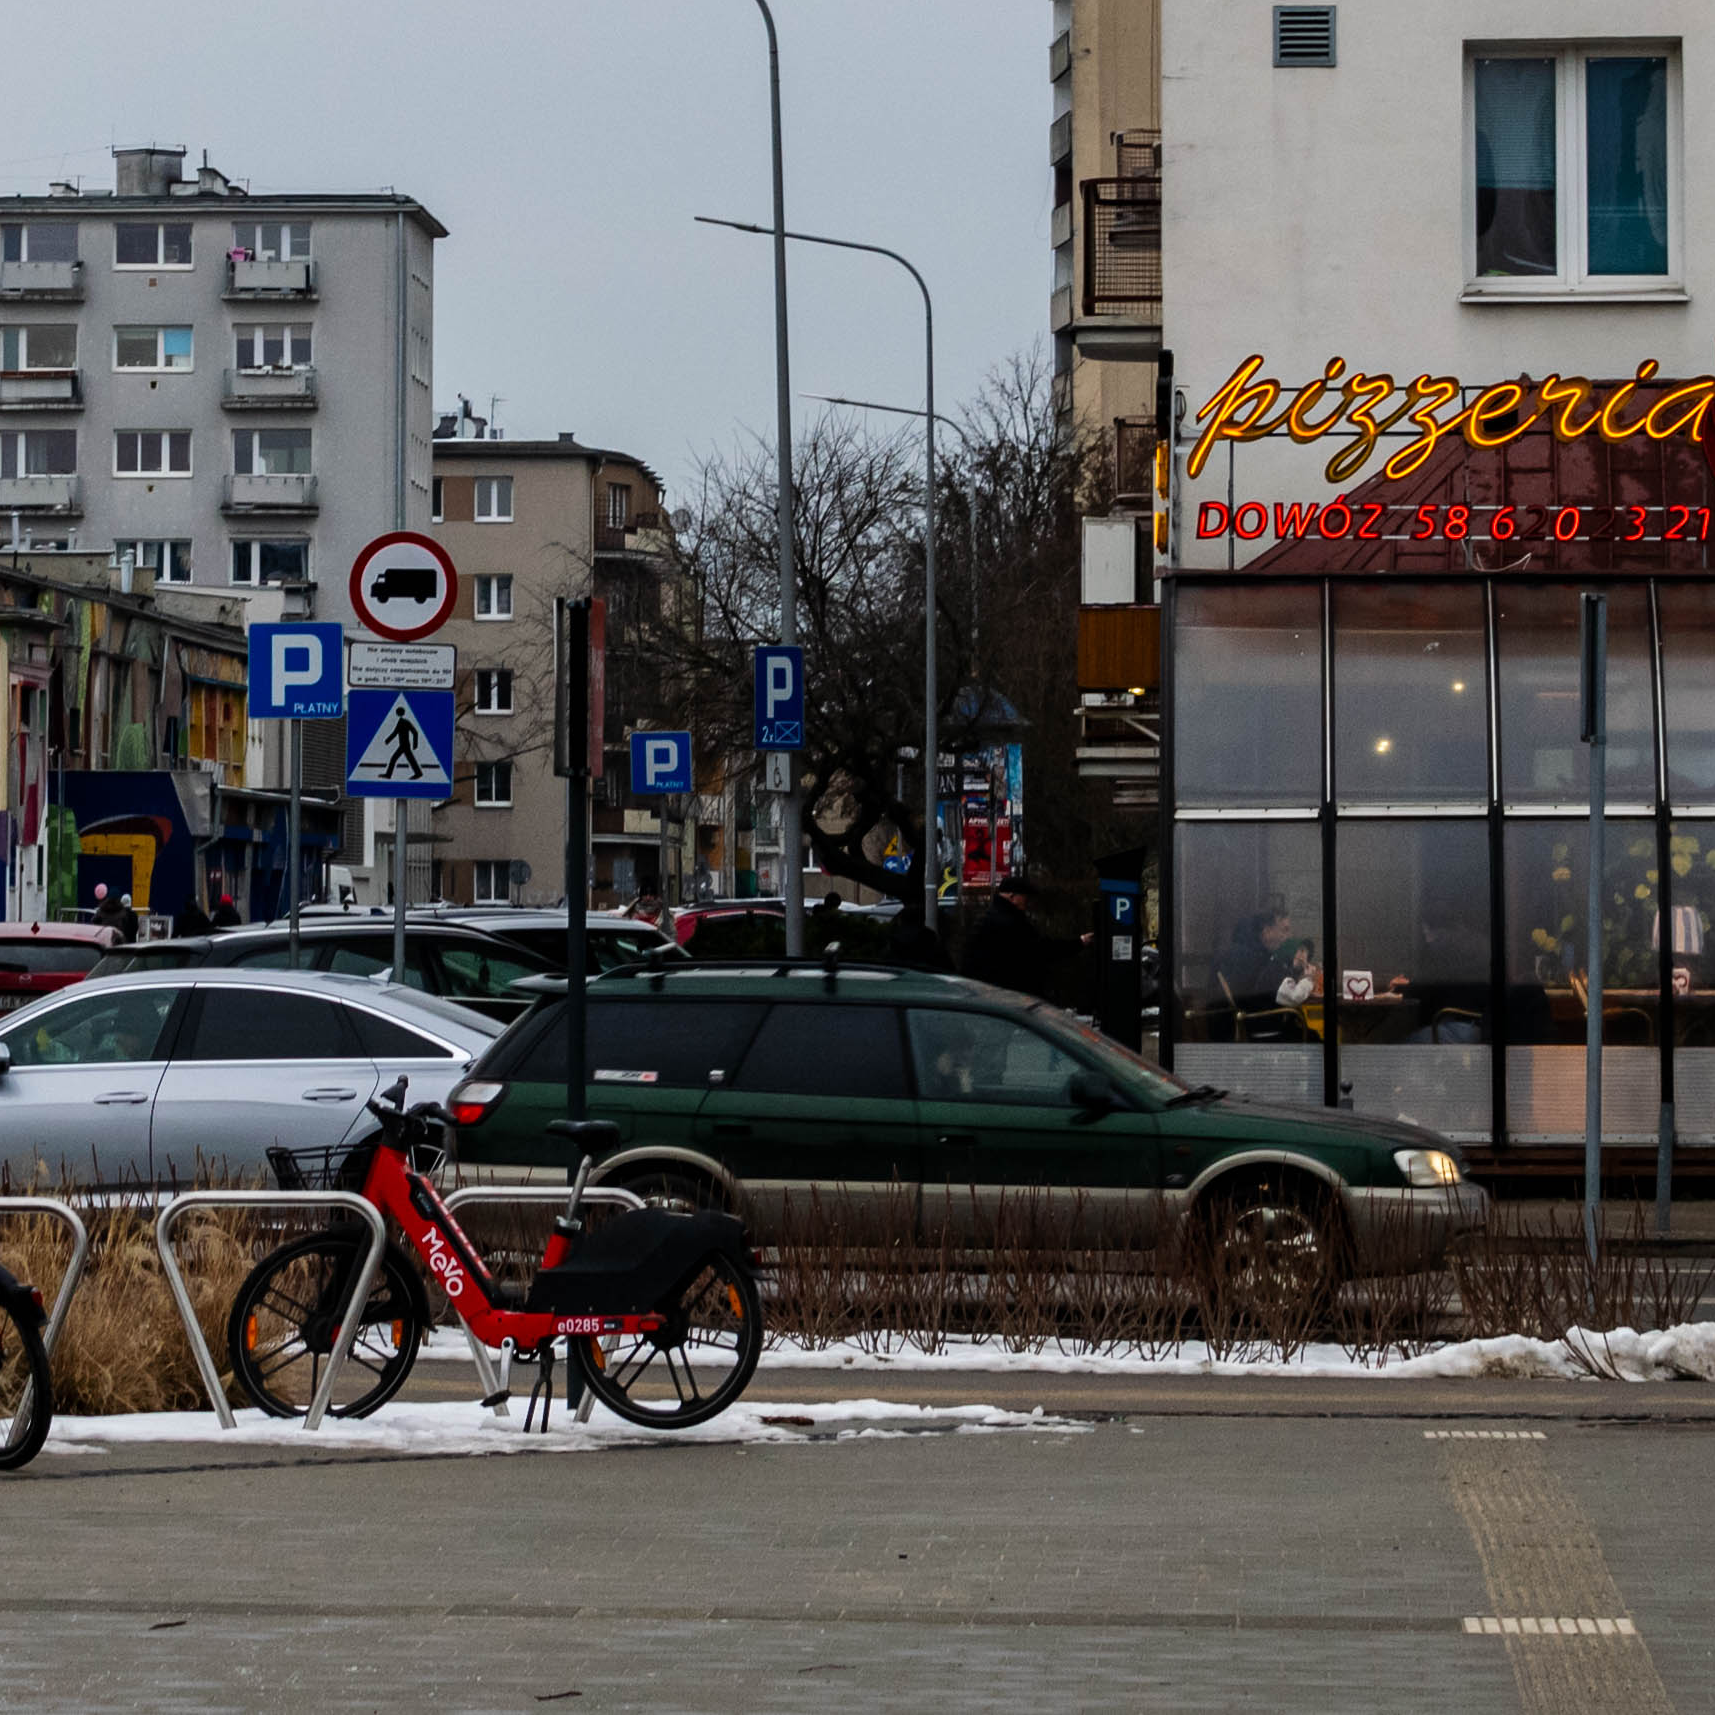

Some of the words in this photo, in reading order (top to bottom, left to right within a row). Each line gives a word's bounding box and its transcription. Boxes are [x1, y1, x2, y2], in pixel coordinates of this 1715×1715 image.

[1197, 494, 1383, 541] DOWÓZ
[1409, 503, 1470, 541] 58
[272, 634, 323, 707] P
[766, 656, 794, 719] P
[646, 739, 678, 786] P
[1116, 897, 1130, 920] P
[557, 1318, 600, 1333] e0285
